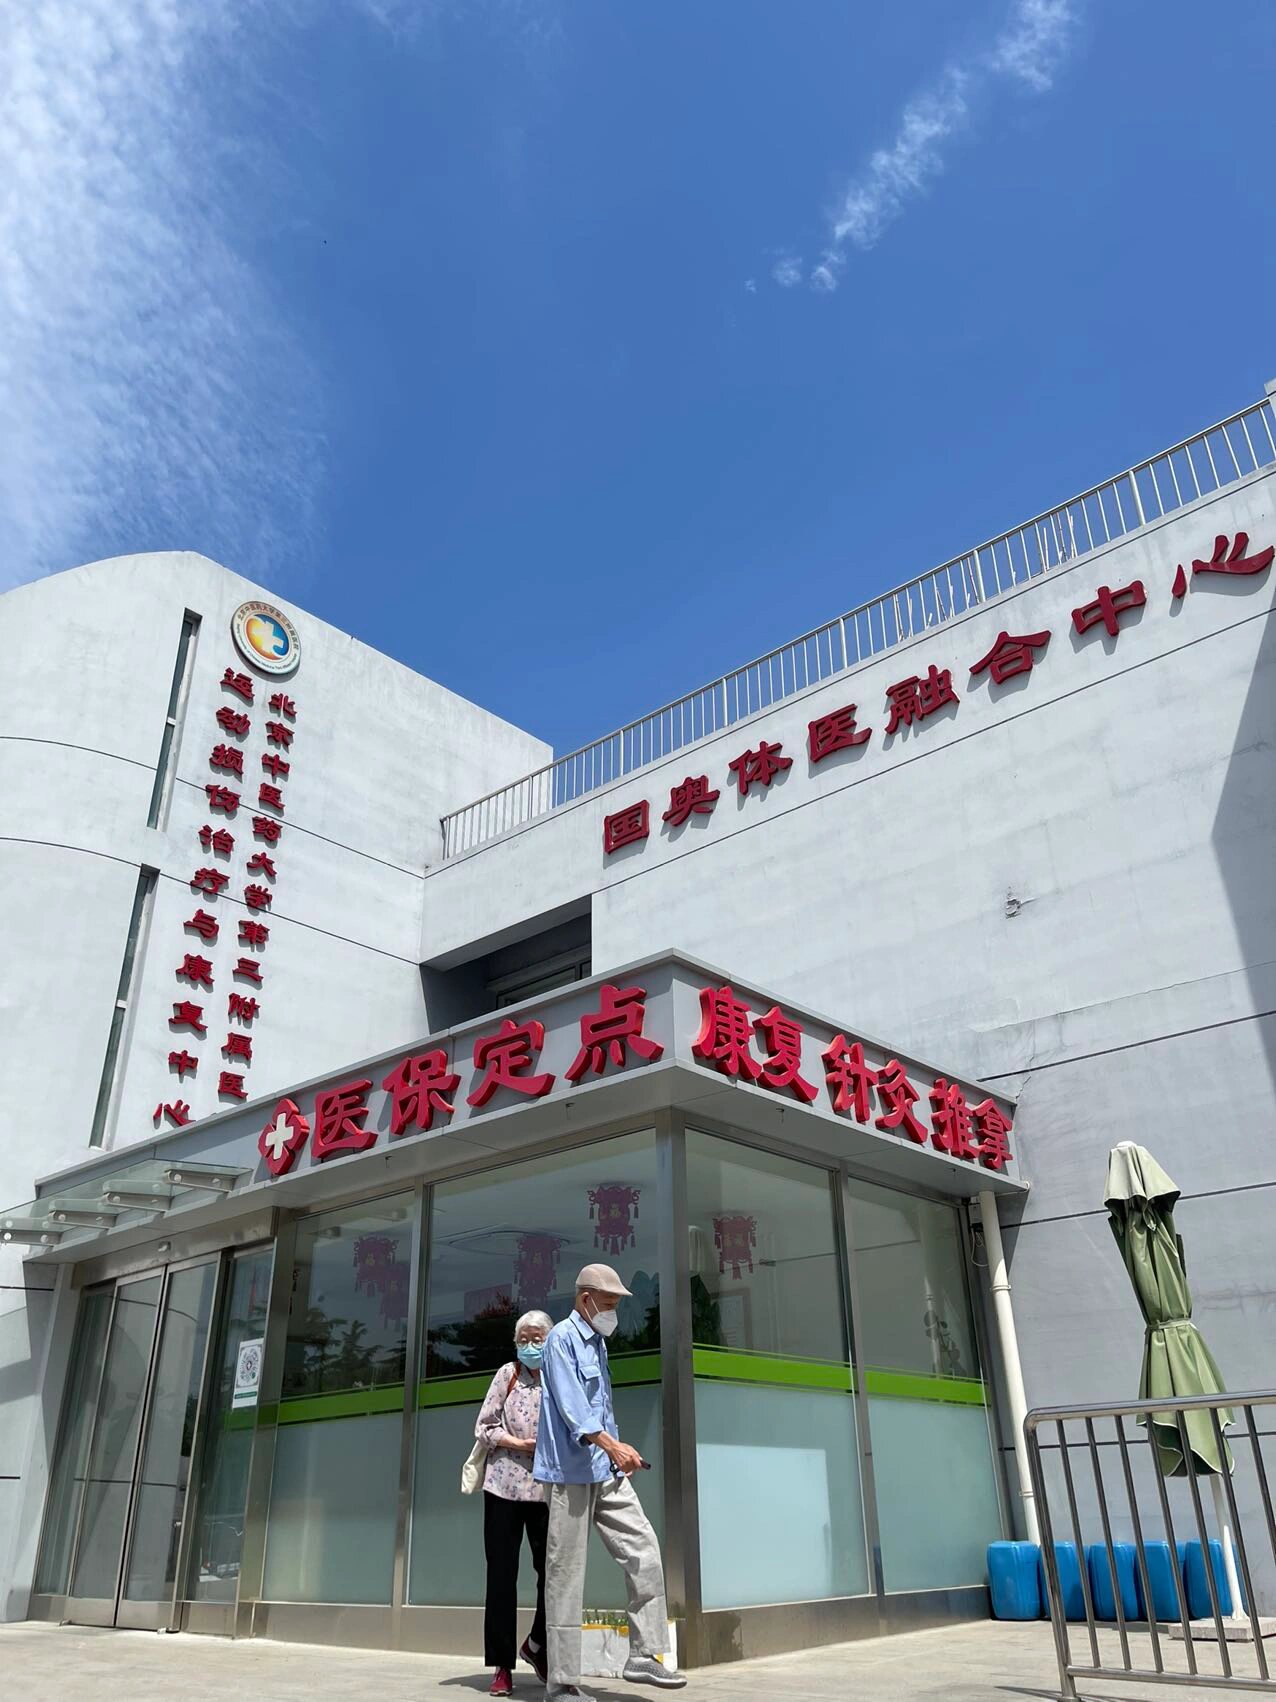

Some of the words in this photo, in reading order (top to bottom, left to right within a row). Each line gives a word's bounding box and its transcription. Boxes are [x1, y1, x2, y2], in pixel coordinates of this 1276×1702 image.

[604, 532, 1274, 853] 国奥体医融合中心
[153, 667, 255, 1126] 运动损伤治疗与康复中心
[311, 983, 664, 1159] 医保定点
